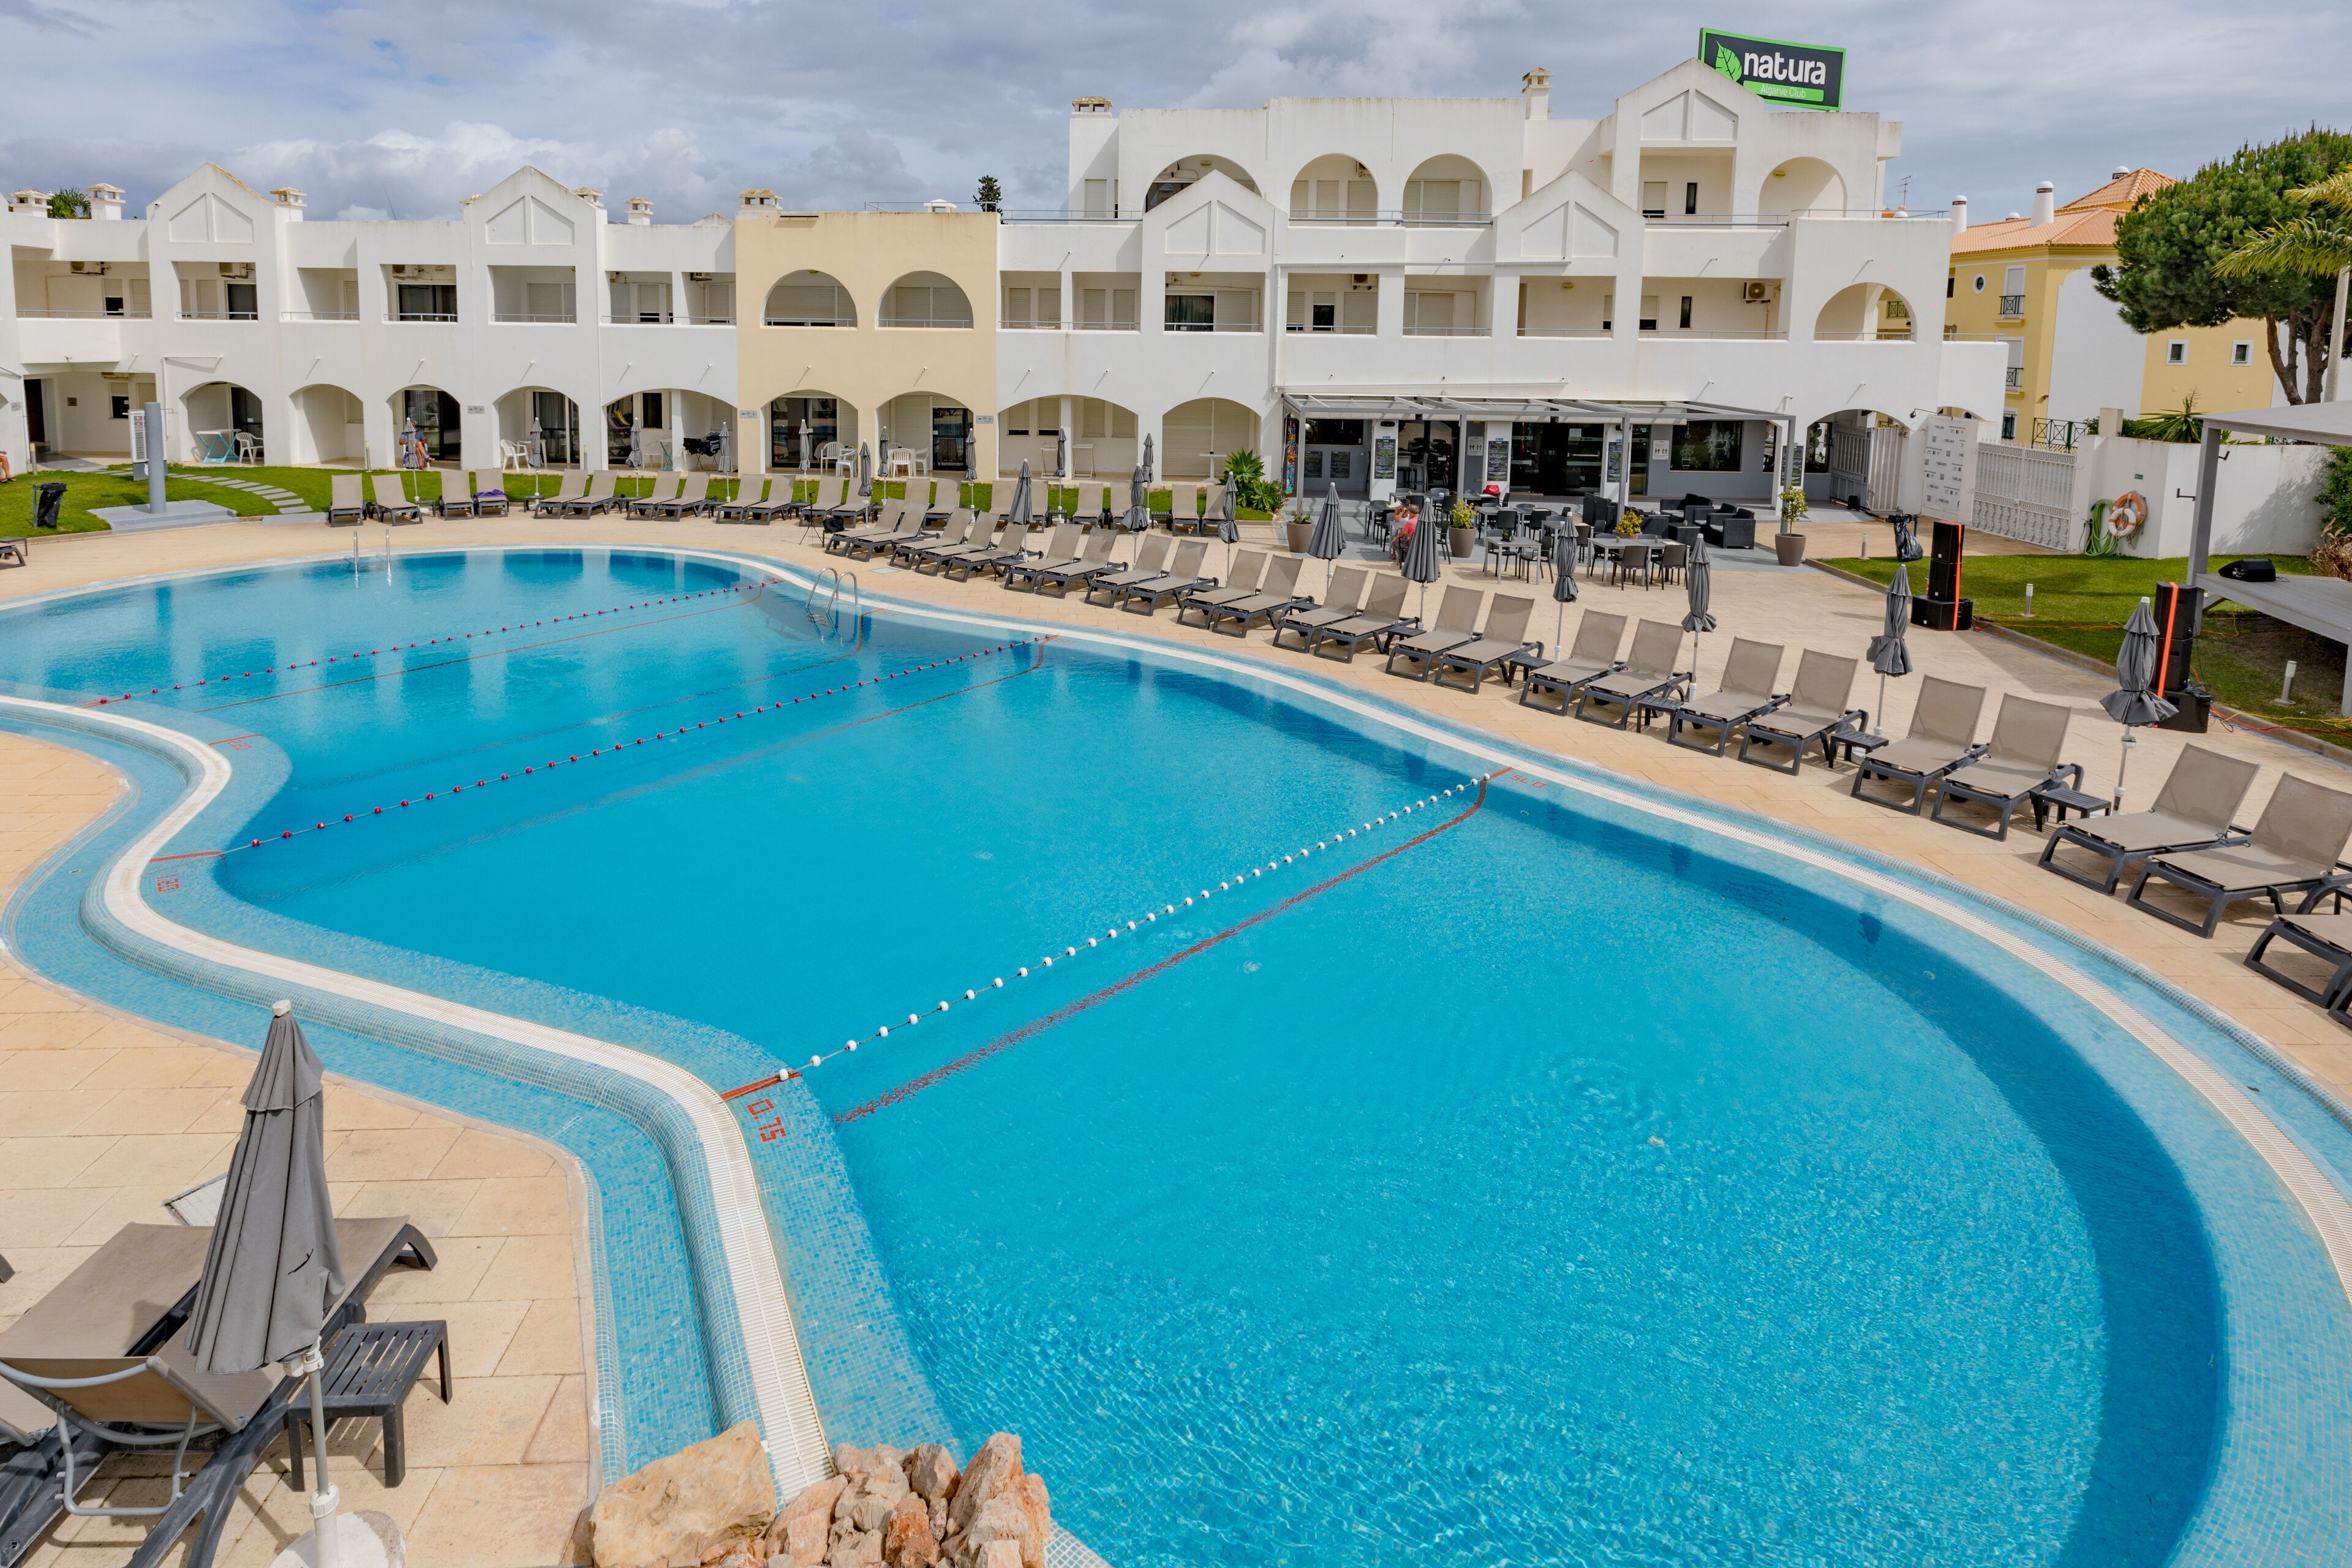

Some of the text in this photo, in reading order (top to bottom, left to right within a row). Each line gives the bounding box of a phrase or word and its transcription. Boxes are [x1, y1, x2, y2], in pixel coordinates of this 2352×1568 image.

[1743, 52, 1826, 85] natura
[1760, 85, 1806, 97] Algarve Club
[747, 1099, 786, 1142] 0.75
